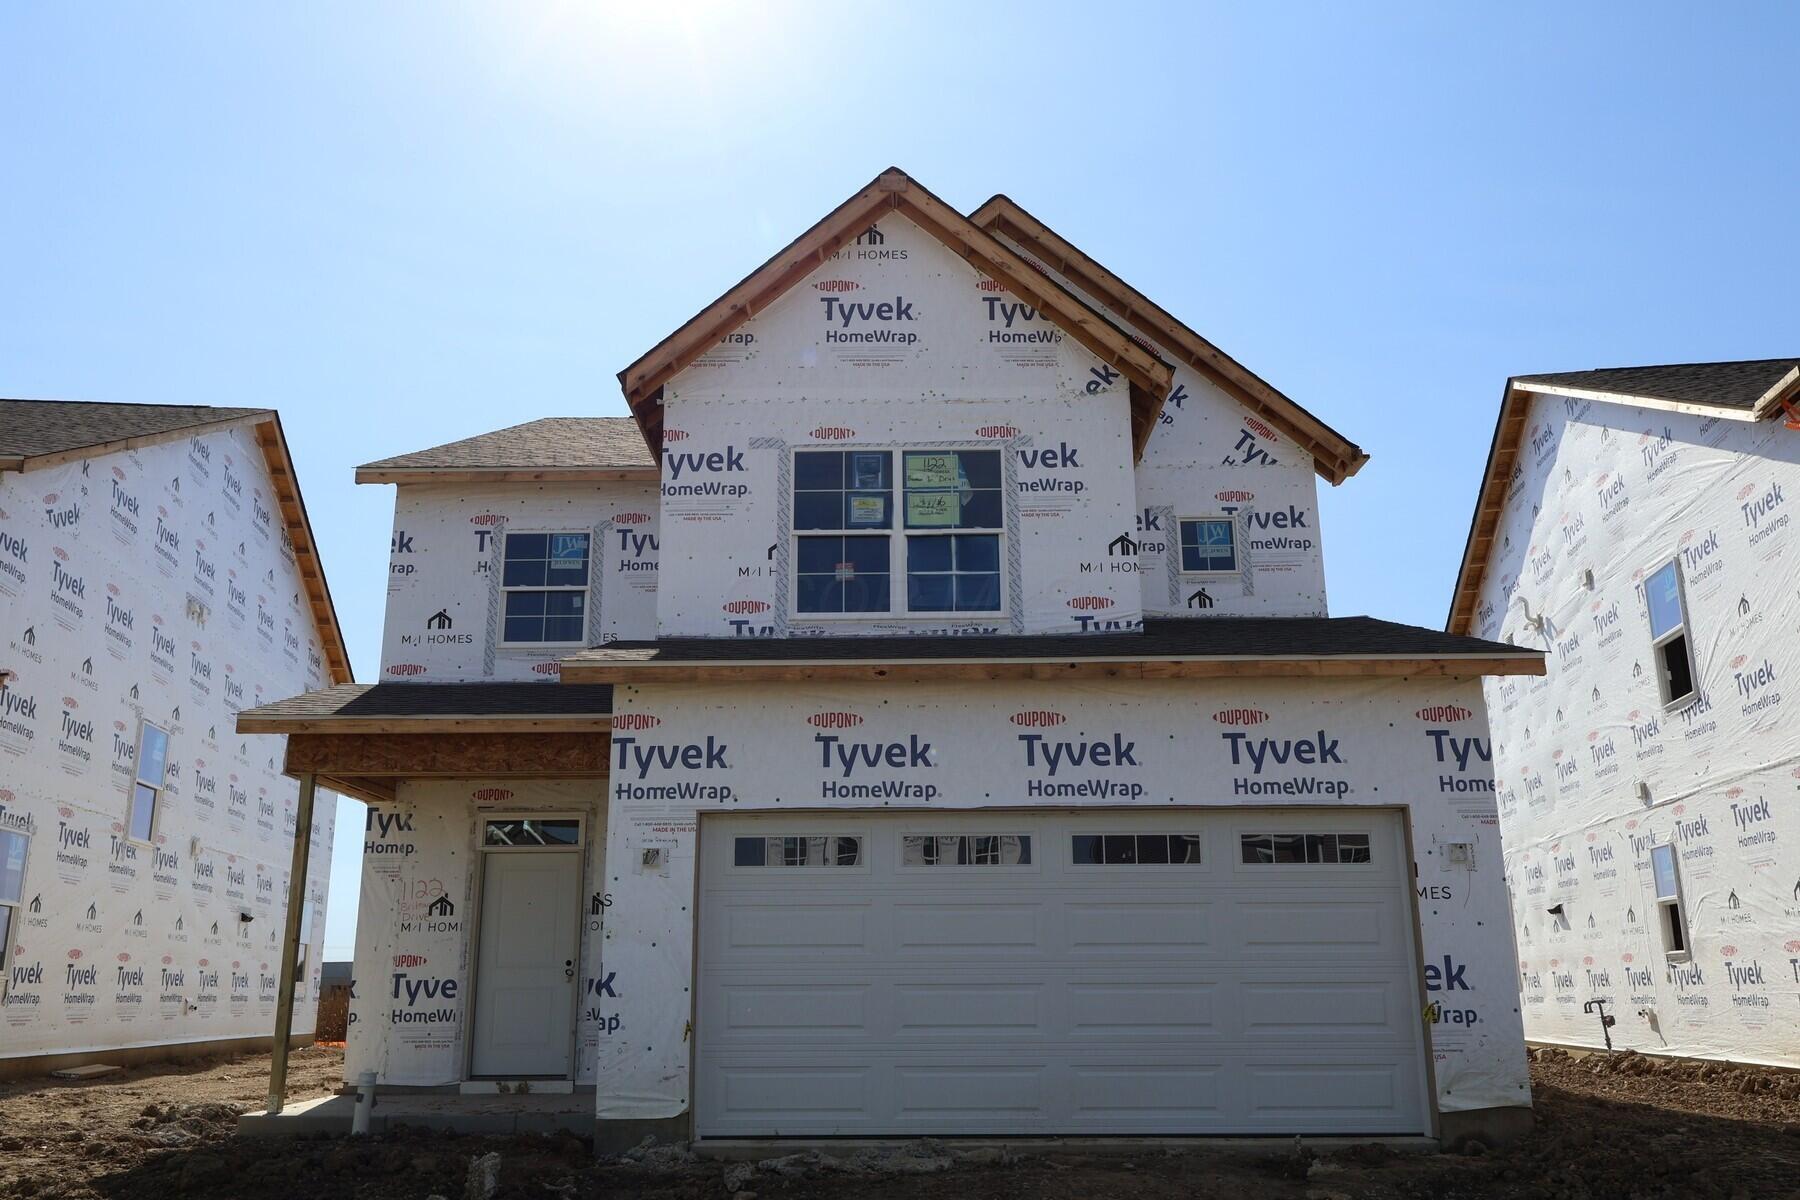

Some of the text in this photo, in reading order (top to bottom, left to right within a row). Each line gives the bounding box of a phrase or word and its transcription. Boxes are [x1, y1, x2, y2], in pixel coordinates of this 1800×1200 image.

[857, 250, 908, 260] HOMES
[819, 280, 855, 292] DUPONT
[980, 280, 1008, 292] DUPO
[820, 296, 914, 328] Tyvek
[982, 297, 1052, 328] Tyv
[826, 330, 917, 345] HomeWrap
[989, 330, 1056, 344] HomeW
[662, 429, 685, 443] PONT
[814, 426, 851, 440] DUPONT
[980, 425, 1017, 439] DUPONT
[1247, 416, 1276, 442] DUPONT
[1016, 442, 1079, 469] vek
[1233, 428, 1278, 466] Tyv
[1641, 426, 1674, 467] Tyvek
[1646, 451, 1678, 484] HomeWrap
[223, 464, 242, 497] Tyvek
[660, 482, 747, 497] HomeWrap
[1017, 478, 1083, 494] meWrap
[1597, 472, 1625, 510] Tyvek
[111, 478, 140, 518] Tyvek
[1219, 490, 1251, 502] DUPONT
[1740, 481, 1785, 529] Tyvek
[110, 505, 138, 535] HomeWrap
[253, 498, 271, 528] Tyvek
[615, 512, 647, 524] DUPONT
[1221, 505, 1305, 530] Tvek
[156, 517, 180, 551] Tyvek
[1562, 512, 1585, 545] Tyvek
[1748, 513, 1790, 548] HomeWrap
[616, 528, 660, 557] Tyv
[1250, 536, 1312, 551] meWrap
[1682, 530, 1721, 570] Tyvek
[195, 549, 215, 582] Tyvek
[620, 559, 659, 573] Home
[738, 566, 761, 577] M/I
[1080, 561, 1141, 573] M/I HOM
[1689, 558, 1724, 588] HomeWrap
[53, 559, 86, 600] Tyvek
[227, 578, 246, 607] Tyvek
[1072, 596, 1110, 610] DUPONT
[50, 591, 84, 619] HomeWrap
[106, 596, 134, 631] Tyvek
[728, 600, 765, 614] DUPONT
[257, 604, 274, 631] Tyvek
[1593, 603, 1620, 635] Tyvek
[104, 623, 132, 648] HomeWrap
[152, 625, 176, 658] Tyvek
[401, 634, 473, 644] M/I HOMES
[1557, 633, 1581, 661] Tyvek
[21, 647, 42, 665] HOMES
[150, 650, 174, 673] HomeWrap
[191, 651, 211, 680] Tyvek
[390, 663, 424, 676] DUPONT
[535, 663, 561, 675] DUPO
[1734, 659, 1776, 700] Tyvek
[224, 674, 244, 700] Tyvek
[0, 684, 37, 720] Tyvek
[1422, 705, 1467, 723] DUPONT
[1679, 689, 1713, 726] Tyvek
[1741, 690, 1781, 717] HomeWrap
[61, 710, 94, 743] Tyvek
[612, 713, 655, 730] DUPONT
[813, 712, 858, 729] DUPONT
[1016, 711, 1061, 728] DUPONT
[1219, 708, 1264, 726] DUPONT
[1630, 715, 1661, 748] Tyvek
[1684, 719, 1717, 742] HomeWrap
[58, 739, 91, 763] HomeWrap
[612, 735, 728, 779] Tyvek
[814, 734, 933, 777] Tyvek
[1018, 733, 1137, 777] Tyvek
[1221, 730, 1343, 775] Tyvek
[1425, 729, 1493, 772] Tyv
[1590, 736, 1616, 766] Tyvek
[1635, 742, 1664, 762] HomeWrap
[1555, 754, 1577, 783] Tyvek
[195, 769, 216, 794] Tyvek
[616, 782, 732, 802] HomeWrap
[822, 780, 937, 802] HomeWrap
[1027, 779, 1143, 800] HomeWrap
[1233, 777, 1350, 800] HomeWrap
[1439, 775, 1495, 792] Home
[1523, 771, 1543, 795] Tyvek
[229, 784, 247, 806] Tyvek
[477, 788, 510, 801] DUPONT
[257, 797, 274, 818] Tyvek
[1730, 795, 1771, 830] Tyvek
[58, 821, 90, 849] Tyvek
[1675, 814, 1710, 844] Tyvek
[1737, 830, 1777, 848] HomeWrap
[56, 850, 88, 869] HomeWrap
[153, 847, 178, 870] Tyvek
[1588, 842, 1614, 867] Tyvek
[1681, 843, 1714, 861] HomeWrap
[108, 861, 136, 877] HomeWrap
[227, 866, 245, 887] Tyvek
[1552, 852, 1576, 879] Tyvek
[1416, 885, 1452, 900] MES
[400, 921, 463, 932] M/I HOM
[1733, 912, 1752, 924] HOMES
[12, 961, 44, 990] yvek
[66, 963, 97, 990] Tyvek
[117, 966, 144, 990] Tyvek
[161, 968, 184, 992] Tyvek
[199, 970, 219, 994] Tyvek
[231, 972, 249, 993] Tyvek
[259, 973, 276, 995] Tyvek
[1551, 969, 1574, 993] Tyvek
[1585, 968, 1611, 993] Tyvek
[1625, 965, 1654, 992] Tyvek
[1671, 961, 1704, 992] Tyvek
[1724, 959, 1766, 993] Tyvek
[63, 991, 96, 1006] HomeWrap
[115, 992, 142, 1005] HomeWrap
[392, 972, 457, 1006] Tyve
[1731, 994, 1769, 1008] HomeWrap
[391, 1007, 456, 1023] HomeW
